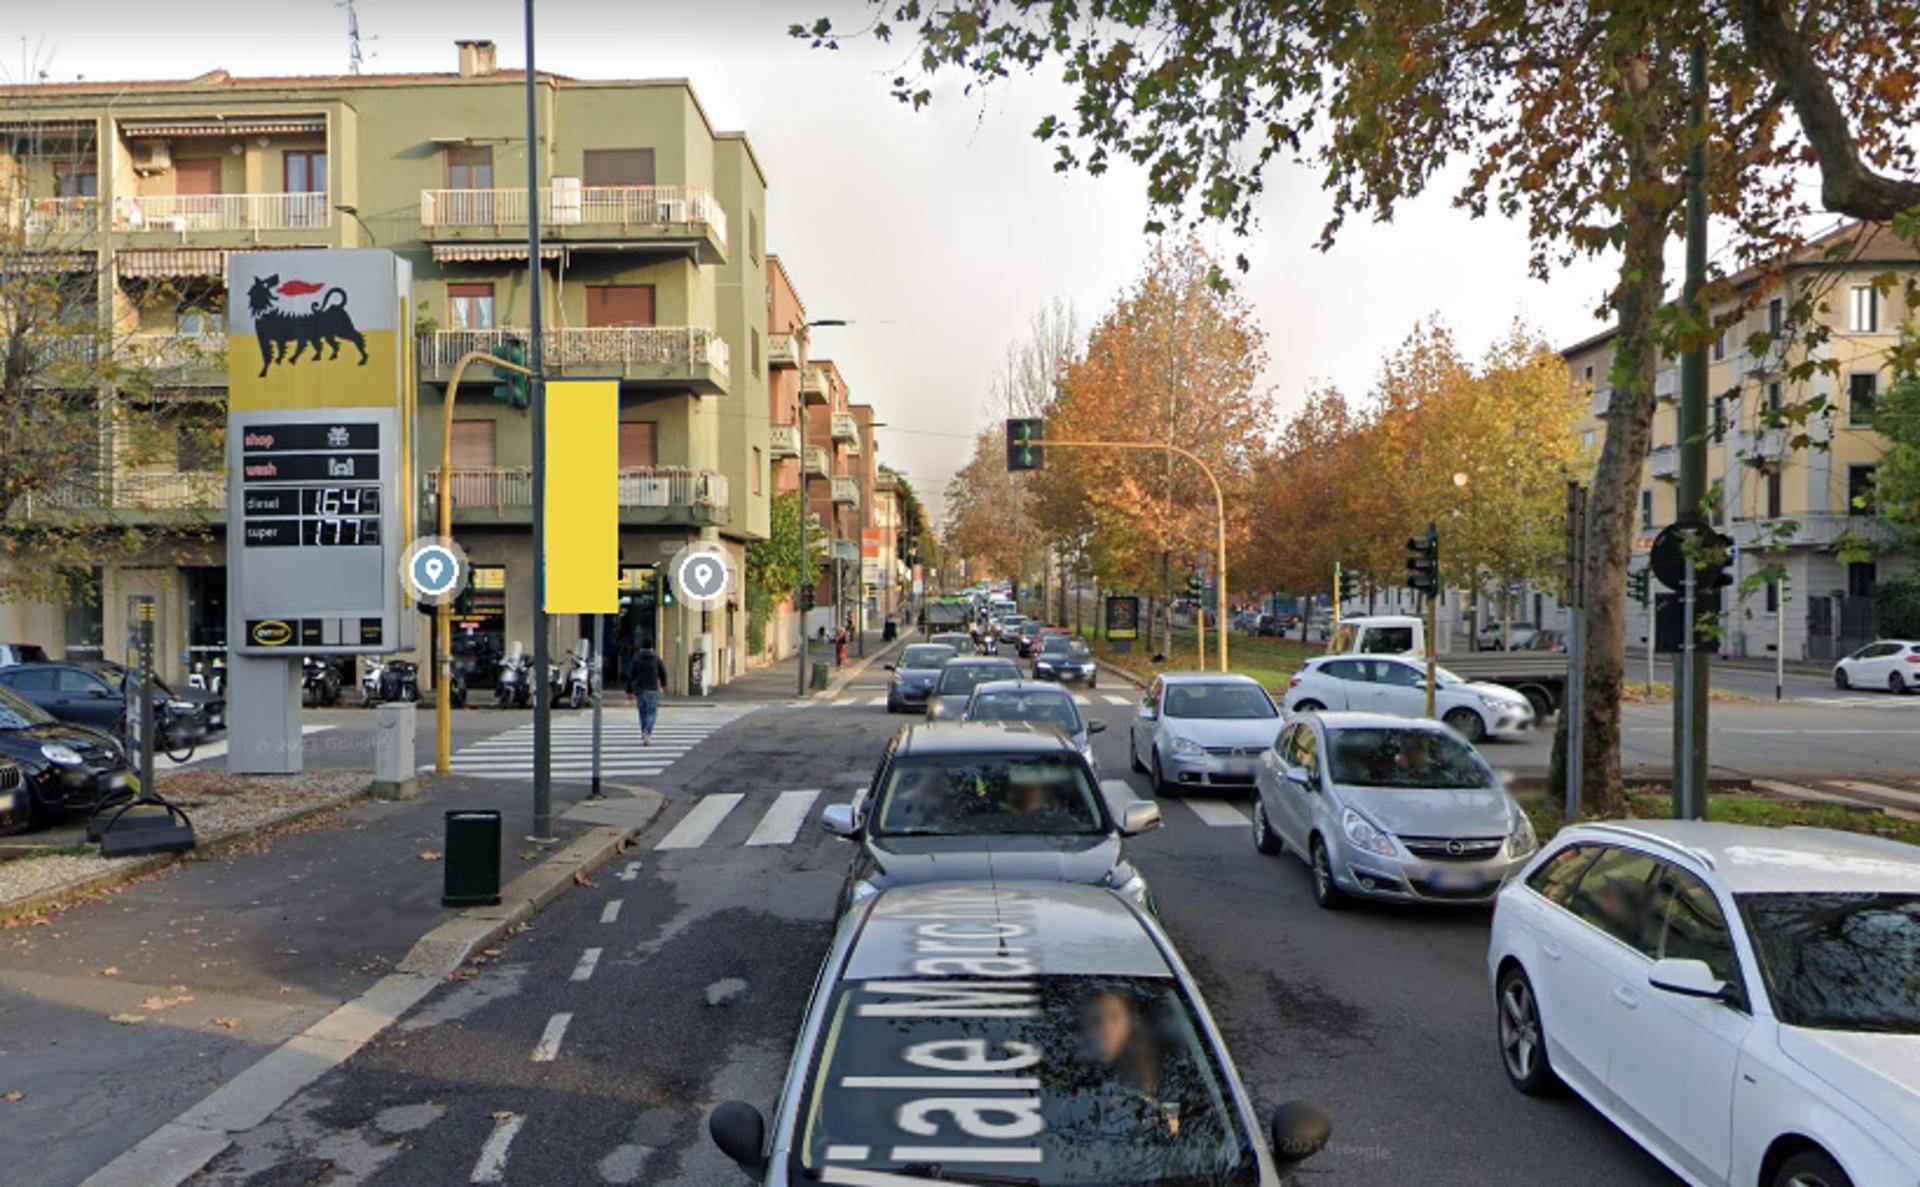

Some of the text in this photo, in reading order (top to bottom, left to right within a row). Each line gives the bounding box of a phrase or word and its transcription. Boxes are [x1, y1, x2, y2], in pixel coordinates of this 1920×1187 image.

[245, 433, 275, 449] shop
[245, 461, 277, 476] wash
[247, 497, 280, 509] diesel
[247, 528, 278, 541] super
